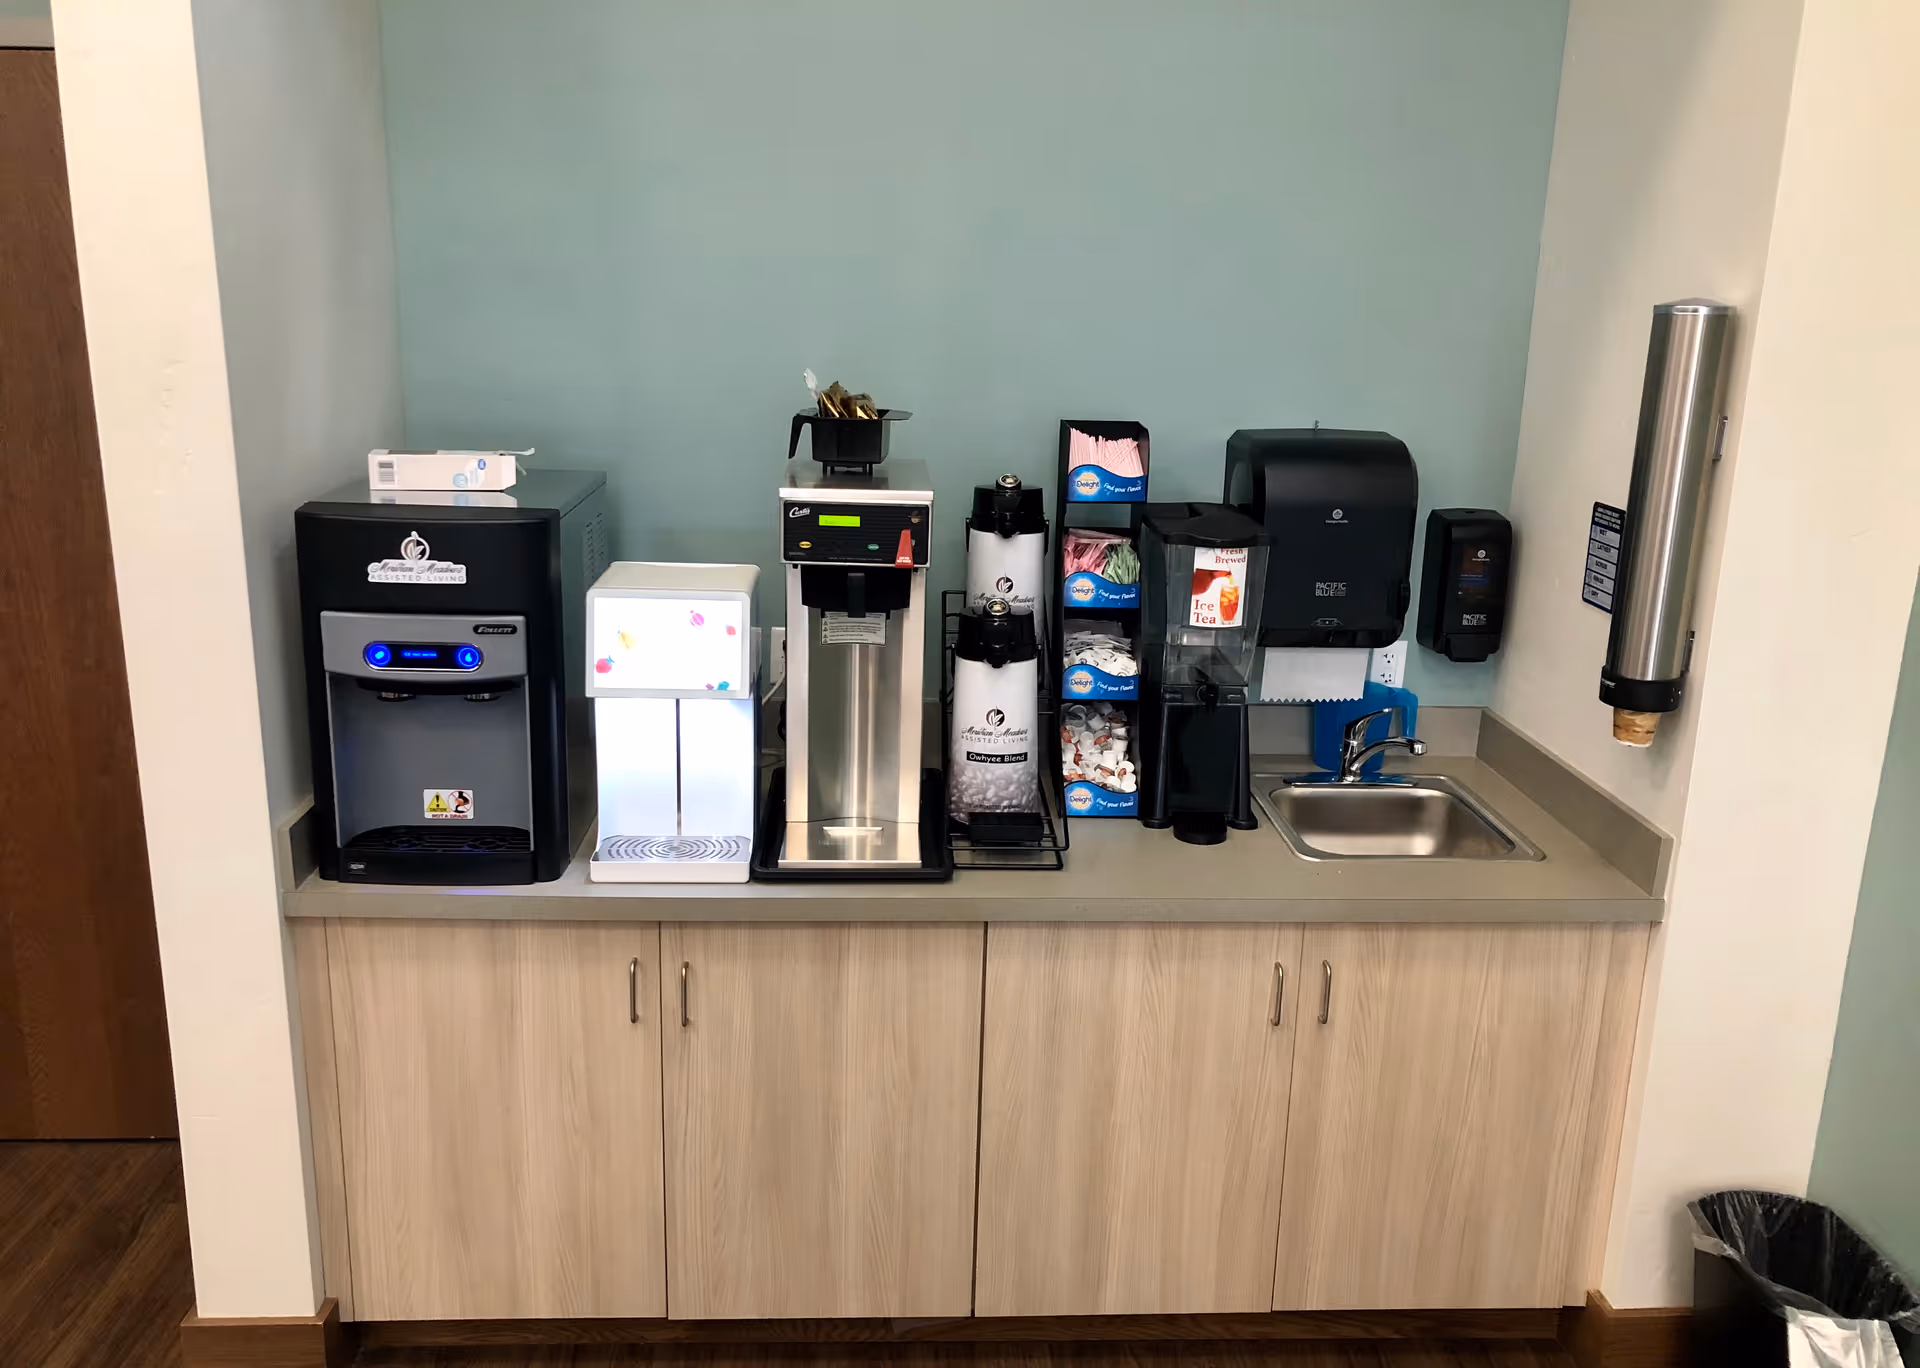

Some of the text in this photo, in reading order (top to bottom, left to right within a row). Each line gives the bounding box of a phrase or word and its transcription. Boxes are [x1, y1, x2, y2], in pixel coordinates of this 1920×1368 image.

[1076, 480, 1099, 489] Delight
[1103, 482, 1115, 491] Find
[1220, 547, 1244, 555] Fresh
[1215, 555, 1246, 564] Brewed
[370, 573, 465, 583] ASSISTED LIVING
[1315, 581, 1347, 590] PACIFIC
[1072, 586, 1094, 595] Delight
[1315, 589, 1335, 597] BLUE
[1194, 599, 1214, 611] Ice
[1193, 611, 1216, 624] Tea
[1463, 613, 1487, 621] PACIFIC
[477, 625, 513, 634] FOLLETT
[1070, 678, 1092, 688] Delight
[961, 734, 1028, 744] ASSISTED LIVING
[969, 752, 1025, 763] Owhyee Blend
[1070, 795, 1092, 804] Delight
